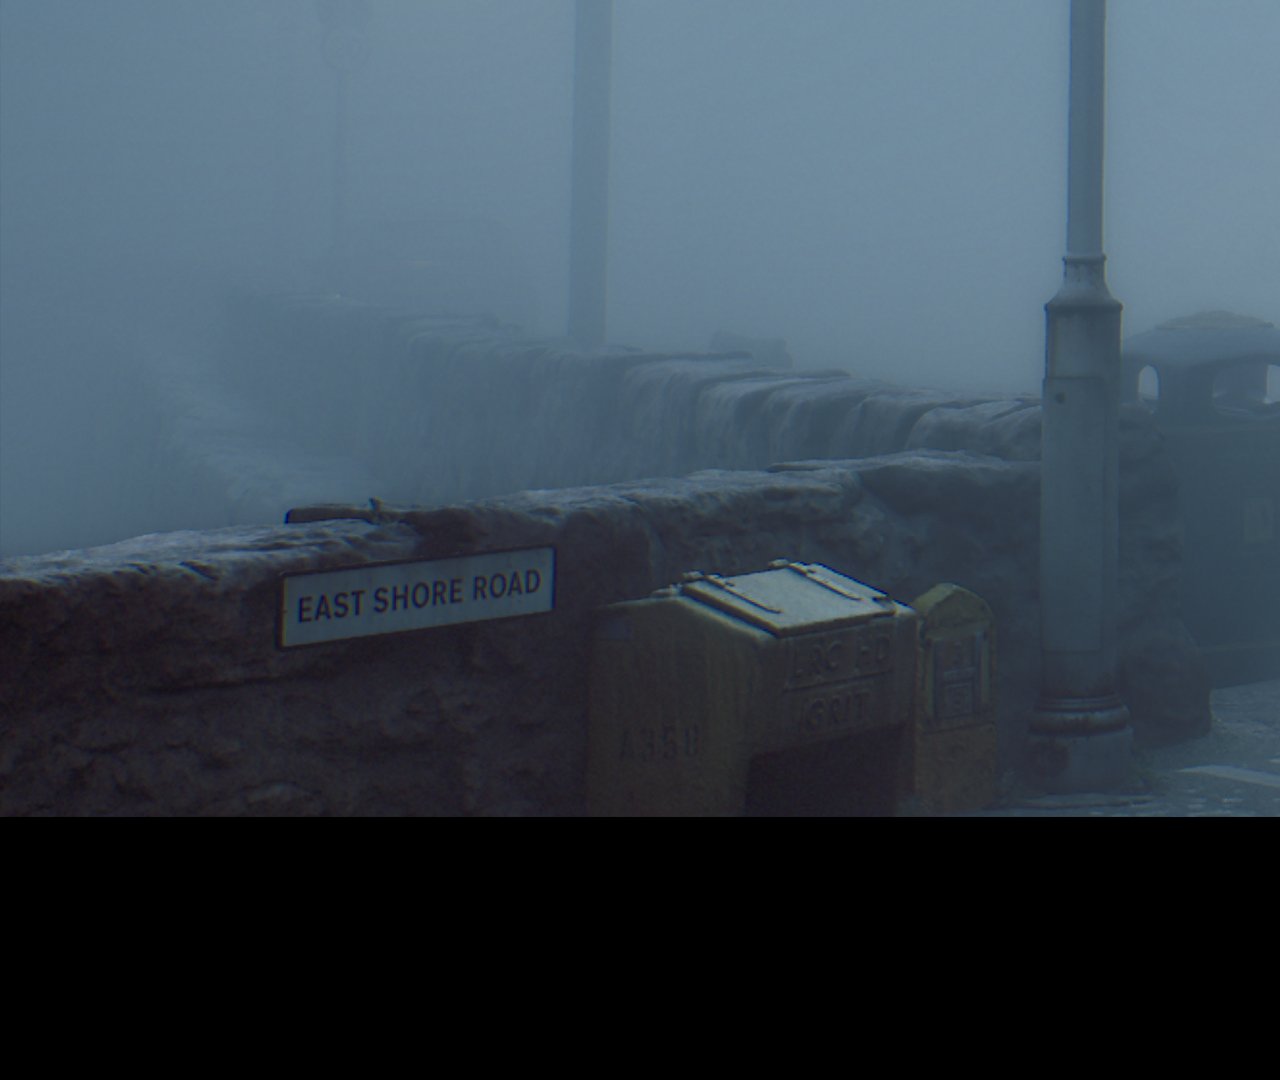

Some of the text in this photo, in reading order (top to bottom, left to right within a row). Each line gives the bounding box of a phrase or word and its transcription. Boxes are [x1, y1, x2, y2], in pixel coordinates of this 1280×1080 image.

[298, 568, 542, 623] EAST SHORE ROAD
[804, 687, 871, 732] GRIT
